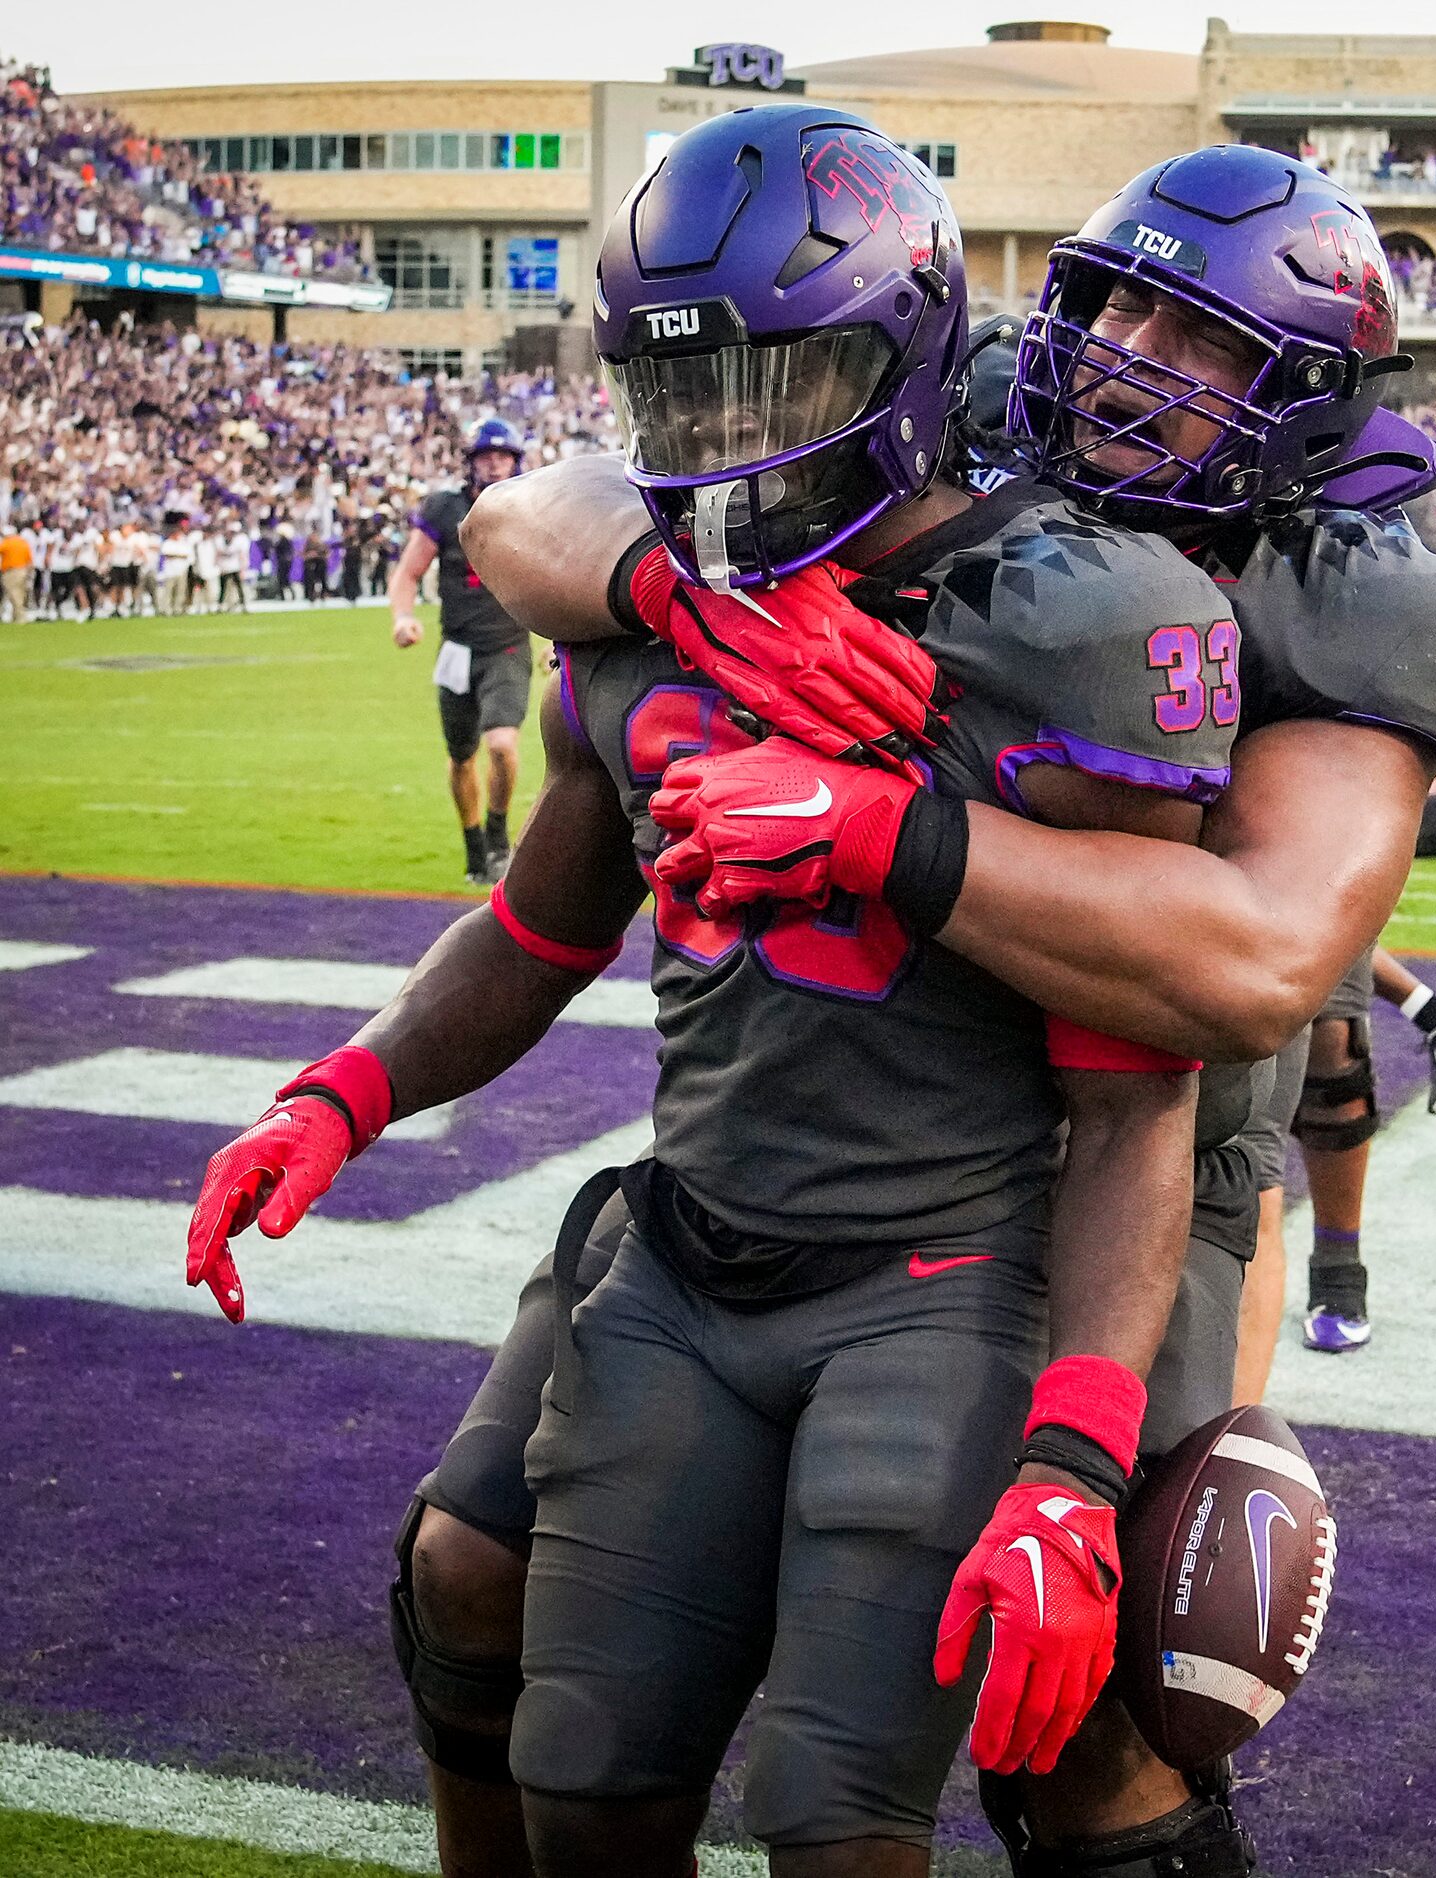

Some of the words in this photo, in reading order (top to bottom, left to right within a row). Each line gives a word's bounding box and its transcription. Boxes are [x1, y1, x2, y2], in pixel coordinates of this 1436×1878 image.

[703, 43, 784, 90] TCU
[1132, 224, 1182, 260] TCU
[646, 308, 700, 339] TCU
[1146, 619, 1240, 734] 33
[1186, 1486, 1218, 1550] VAPOR
[1174, 1551, 1197, 1616] ELITE
